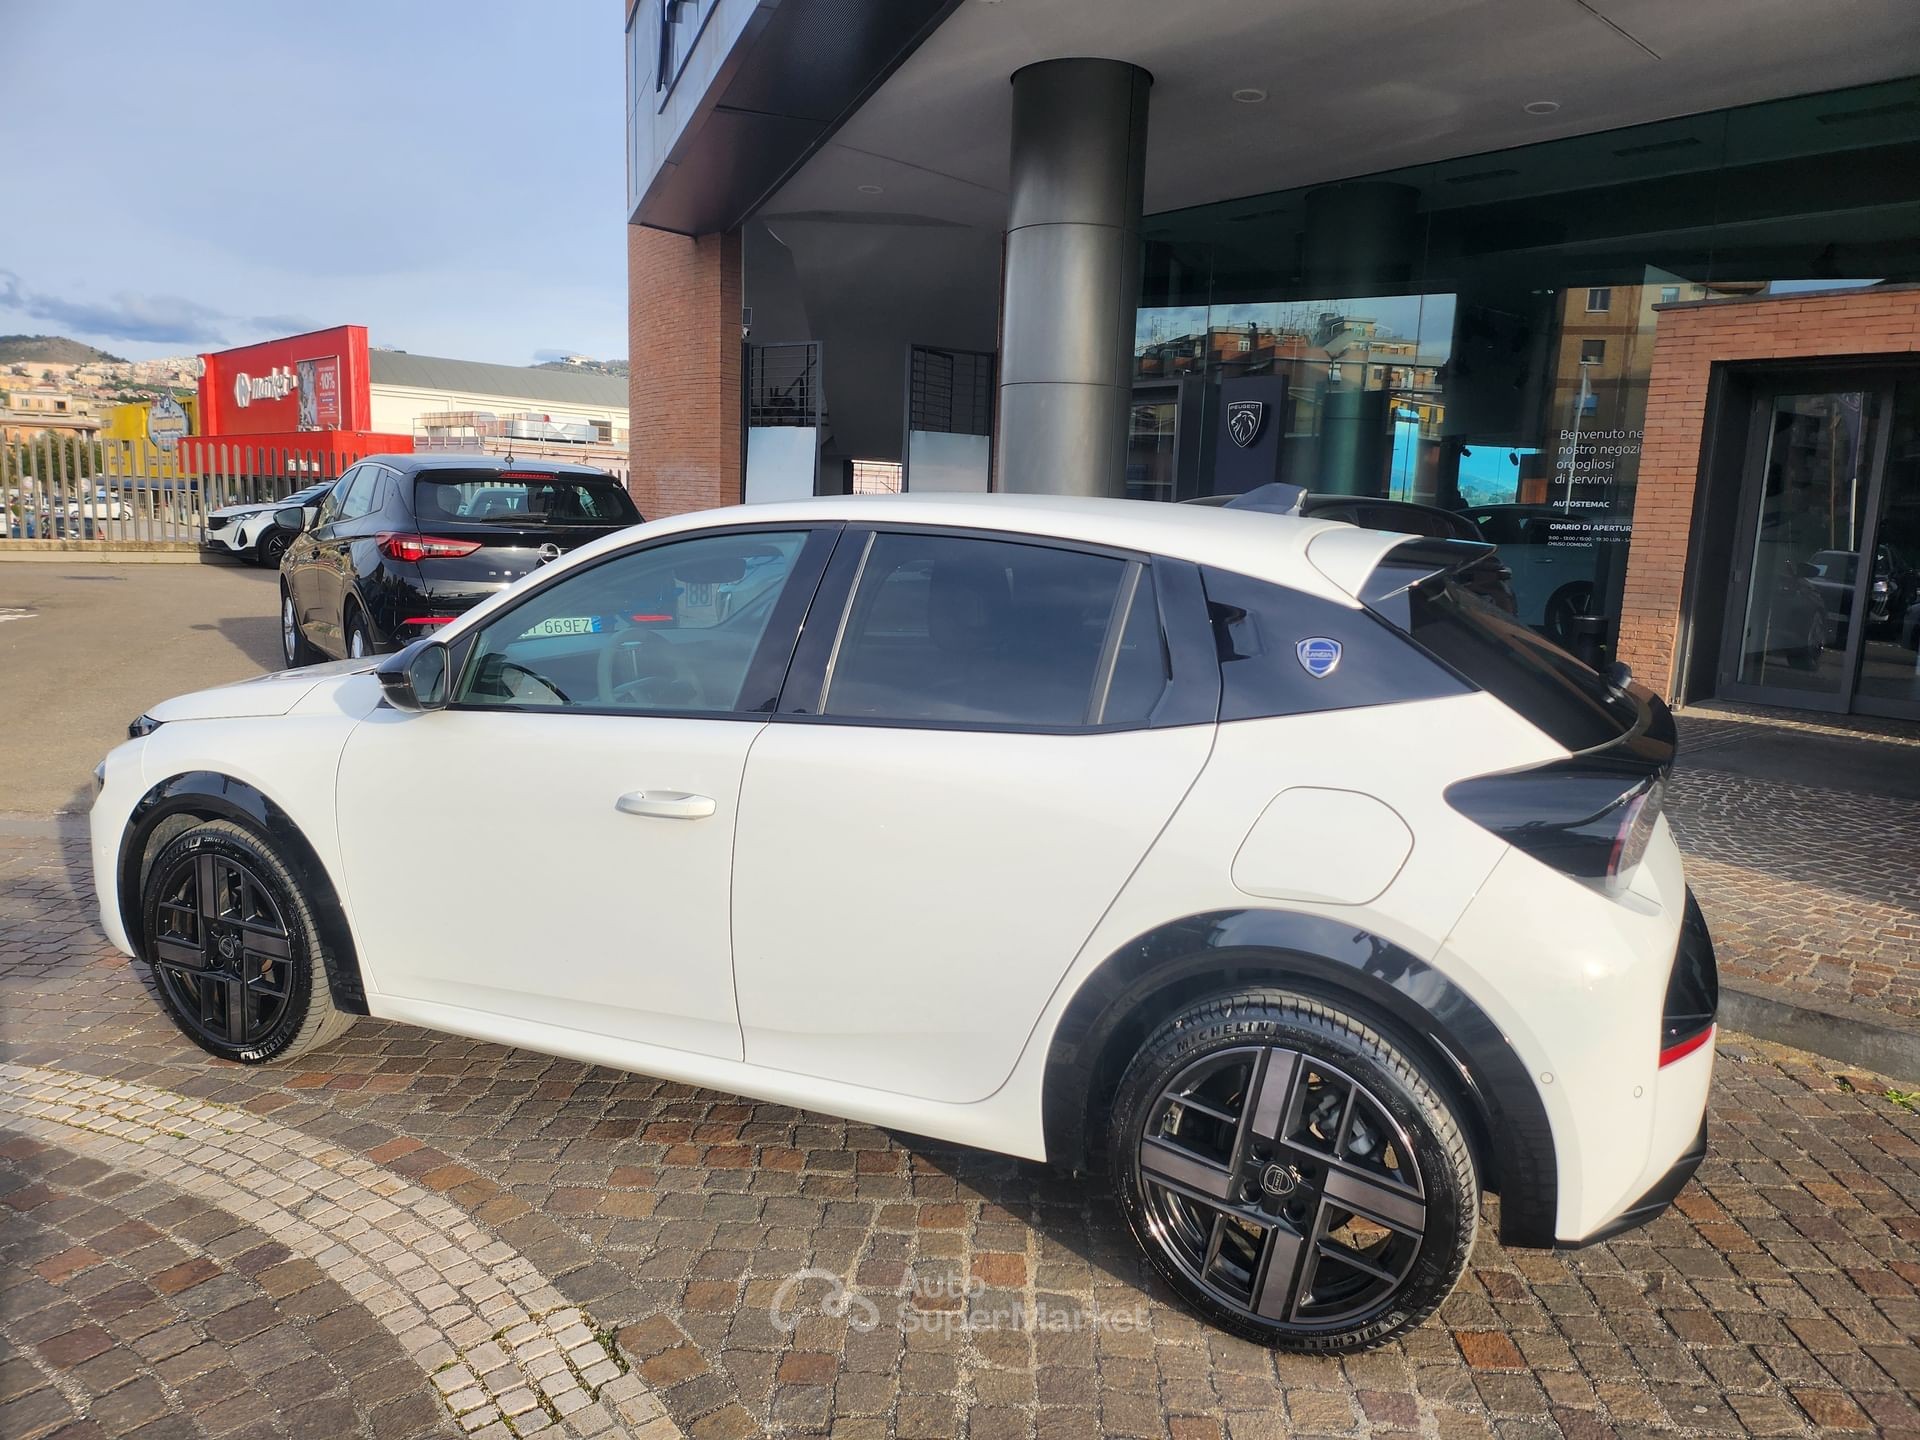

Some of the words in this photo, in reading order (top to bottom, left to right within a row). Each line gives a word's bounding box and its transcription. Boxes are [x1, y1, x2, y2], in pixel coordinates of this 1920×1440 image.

[1560, 429, 1625, 440] Benvenuto
[1628, 430, 1644, 439] ne
[1558, 445, 1597, 455] nostro
[1599, 443, 1641, 457] negozi
[1556, 458, 1615, 472] orgogliosi
[1554, 473, 1566, 484] di
[1569, 473, 1613, 484] servirvi
[1552, 500, 1611, 508] AUTOSTEMAC
[1549, 523, 1581, 531] ORARIO
[1592, 524, 1633, 532] APERTUR
[544, 619, 591, 634] 669EZ
